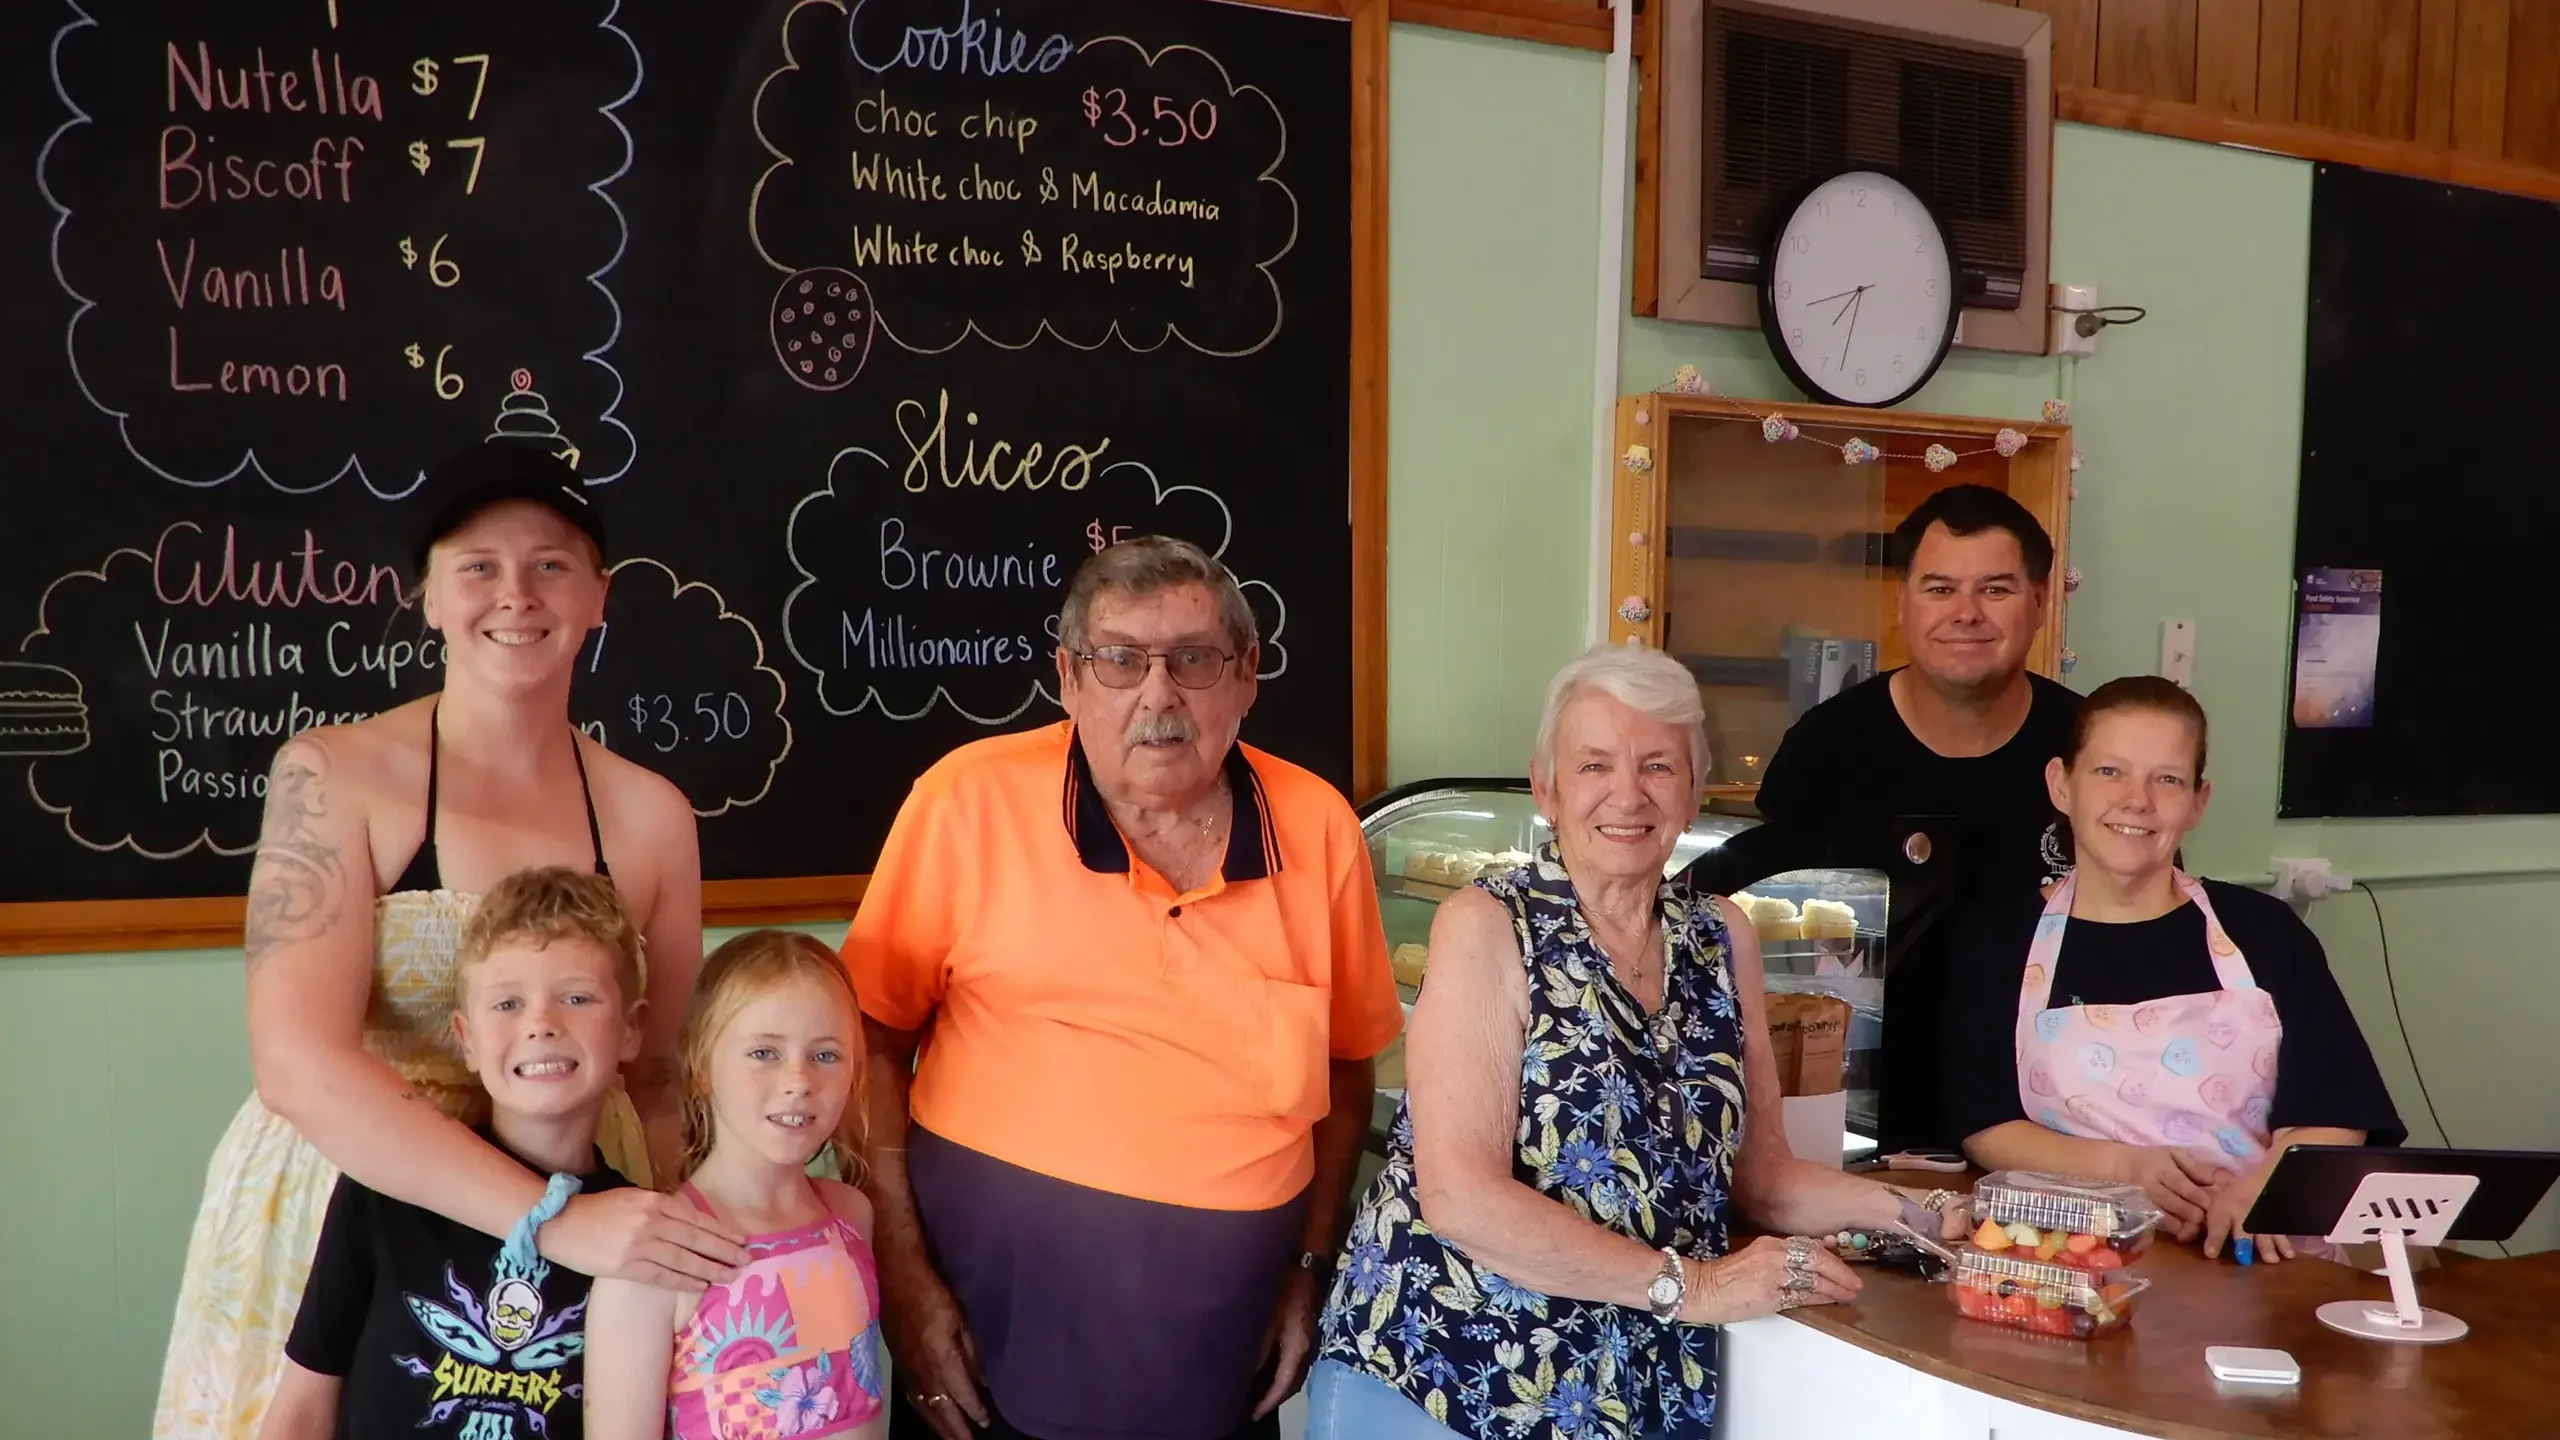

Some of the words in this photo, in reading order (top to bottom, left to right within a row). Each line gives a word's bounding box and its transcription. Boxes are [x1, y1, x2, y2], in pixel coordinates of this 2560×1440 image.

[849, 0, 1073, 74] Cookies
[168, 42, 382, 121] Nutella
[412, 54, 489, 120] $7
[961, 100, 1037, 154] chip
[1083, 86, 1216, 146] $3.50
[160, 127, 364, 208] Biscoff
[409, 137, 485, 194] $7
[853, 151, 947, 201] White
[959, 163, 1021, 200] choc
[1073, 171, 1219, 220] Macadamia
[1815, 200, 1830, 218] 11
[1850, 188, 1868, 208] 12
[157, 239, 345, 310] Vanilla
[400, 234, 460, 287] $6
[854, 224, 938, 267] White
[949, 236, 1003, 266] choc
[1063, 233, 1193, 287] Raspberry
[1790, 234, 1810, 255] 10
[1914, 234, 1926, 254] 2
[1779, 280, 1792, 300] 9
[1925, 278, 1938, 298] 3
[170, 327, 346, 400] Lemon
[405, 343, 464, 399] $6
[1791, 328, 1804, 348] 8
[1819, 356, 1829, 372] 7
[1892, 354, 1904, 374] 5
[1915, 326, 1926, 343] 4
[1855, 368, 1867, 388] 6
[896, 388, 1111, 492] Slices
[881, 518, 1061, 589] Brownie
[135, 619, 304, 678] Vanilla
[327, 620, 447, 689] Cupc
[843, 608, 1032, 668] Millionaires
[629, 693, 750, 751] $3.50
[432, 1352, 563, 1415] SURFERS
